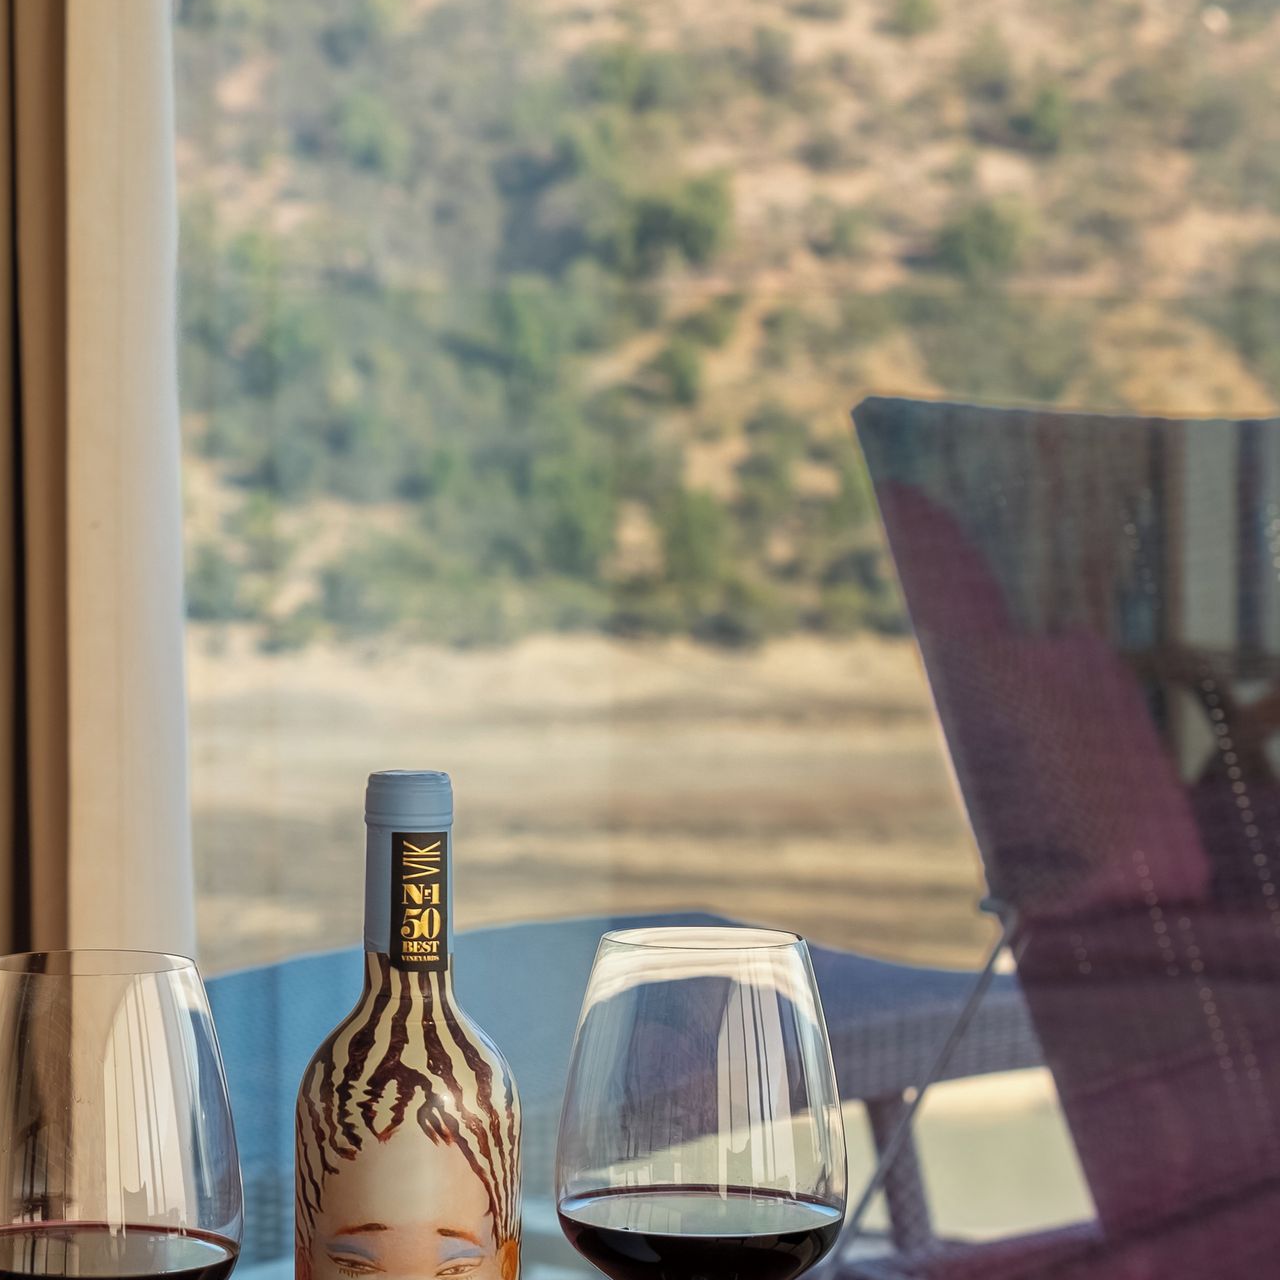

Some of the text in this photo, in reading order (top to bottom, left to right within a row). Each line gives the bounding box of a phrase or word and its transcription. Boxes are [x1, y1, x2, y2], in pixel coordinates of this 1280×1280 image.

[403, 841, 441, 880] VIK
[401, 907, 441, 940] 50
[401, 954, 440, 962] VINEYARDS
[402, 941, 440, 953] BEST
